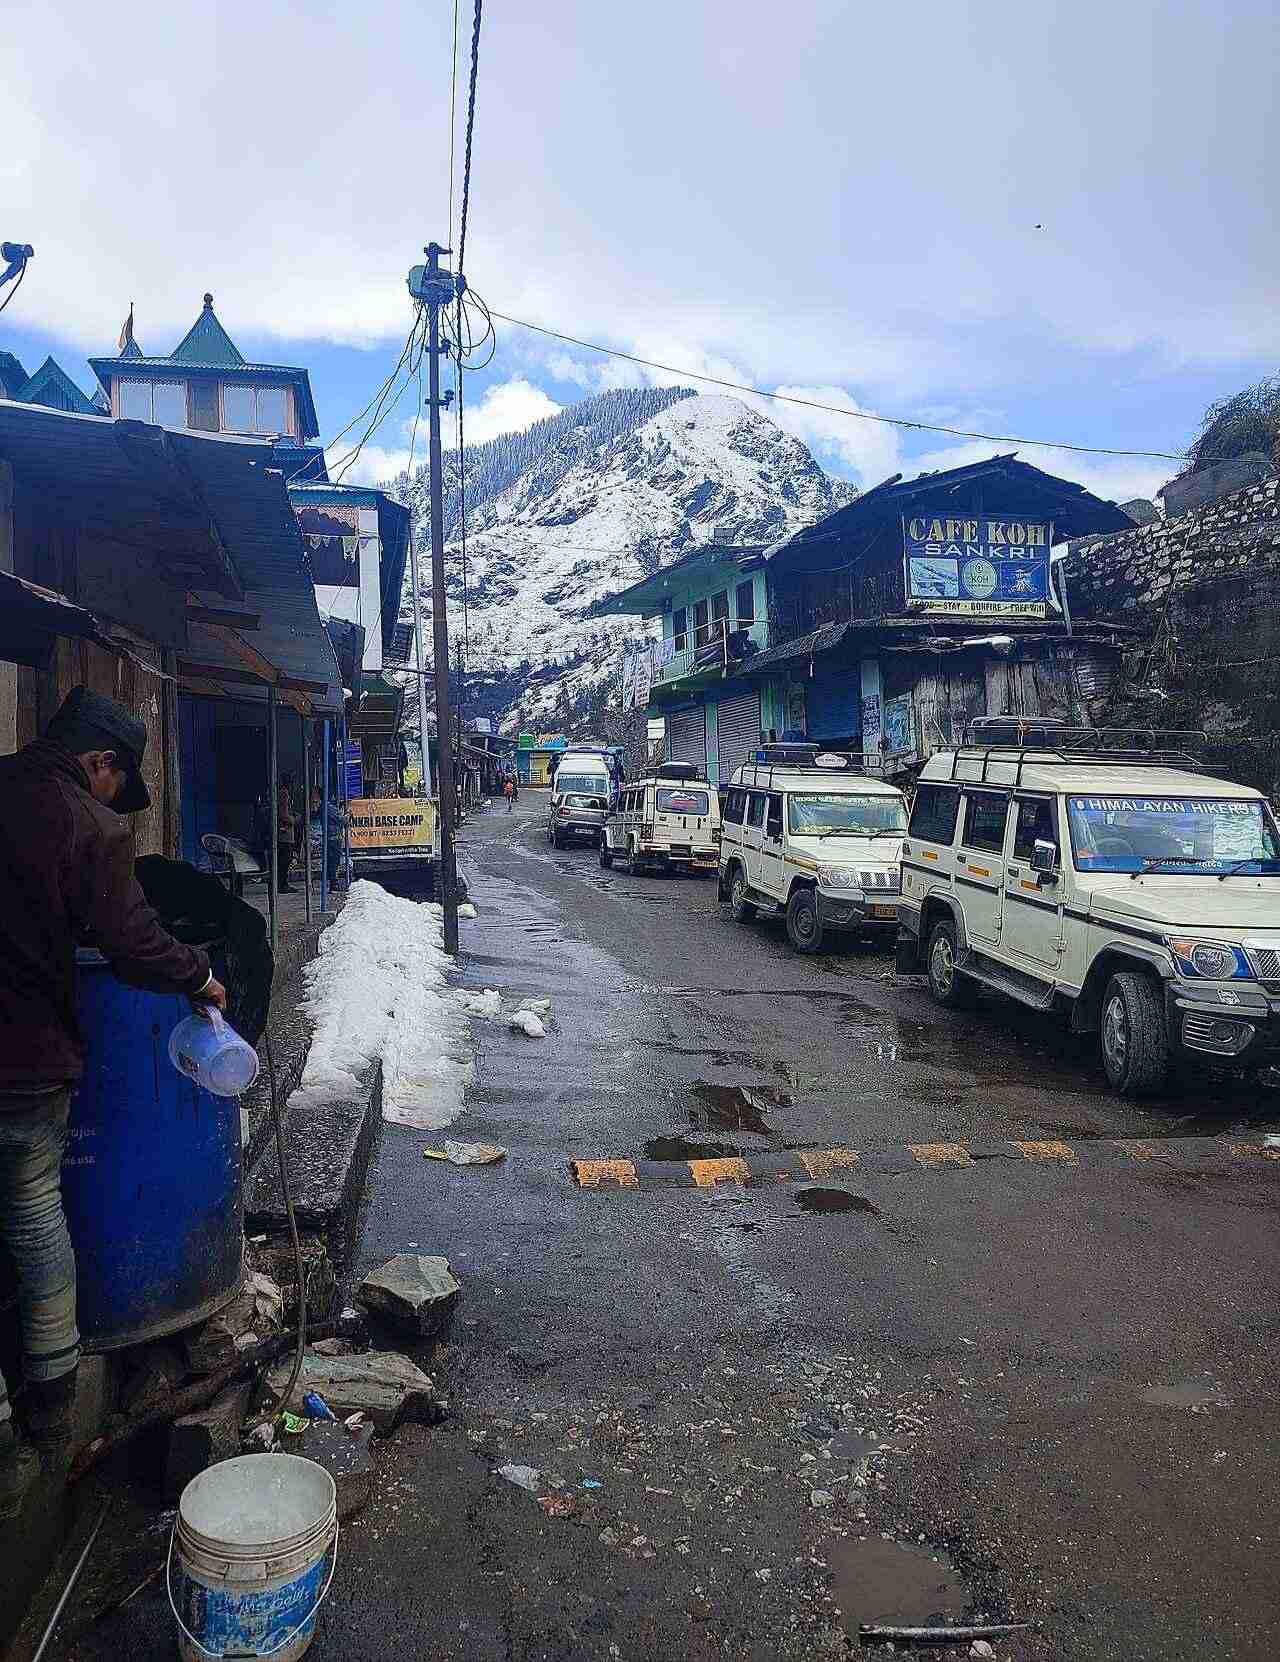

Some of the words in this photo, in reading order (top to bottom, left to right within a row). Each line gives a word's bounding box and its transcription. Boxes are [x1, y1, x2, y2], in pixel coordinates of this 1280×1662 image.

[909, 517, 979, 544] CAFE
[986, 520, 1047, 546] KOH
[924, 543, 1035, 560] SANKRI
[943, 602, 961, 611] STAY
[970, 602, 1001, 612] BONFIRE
[1090, 799, 1184, 813] HIMALAYAN
[1191, 802, 1249, 815] HIKERS
[375, 815, 398, 828] BASE
[399, 814, 424, 827] CAMP
